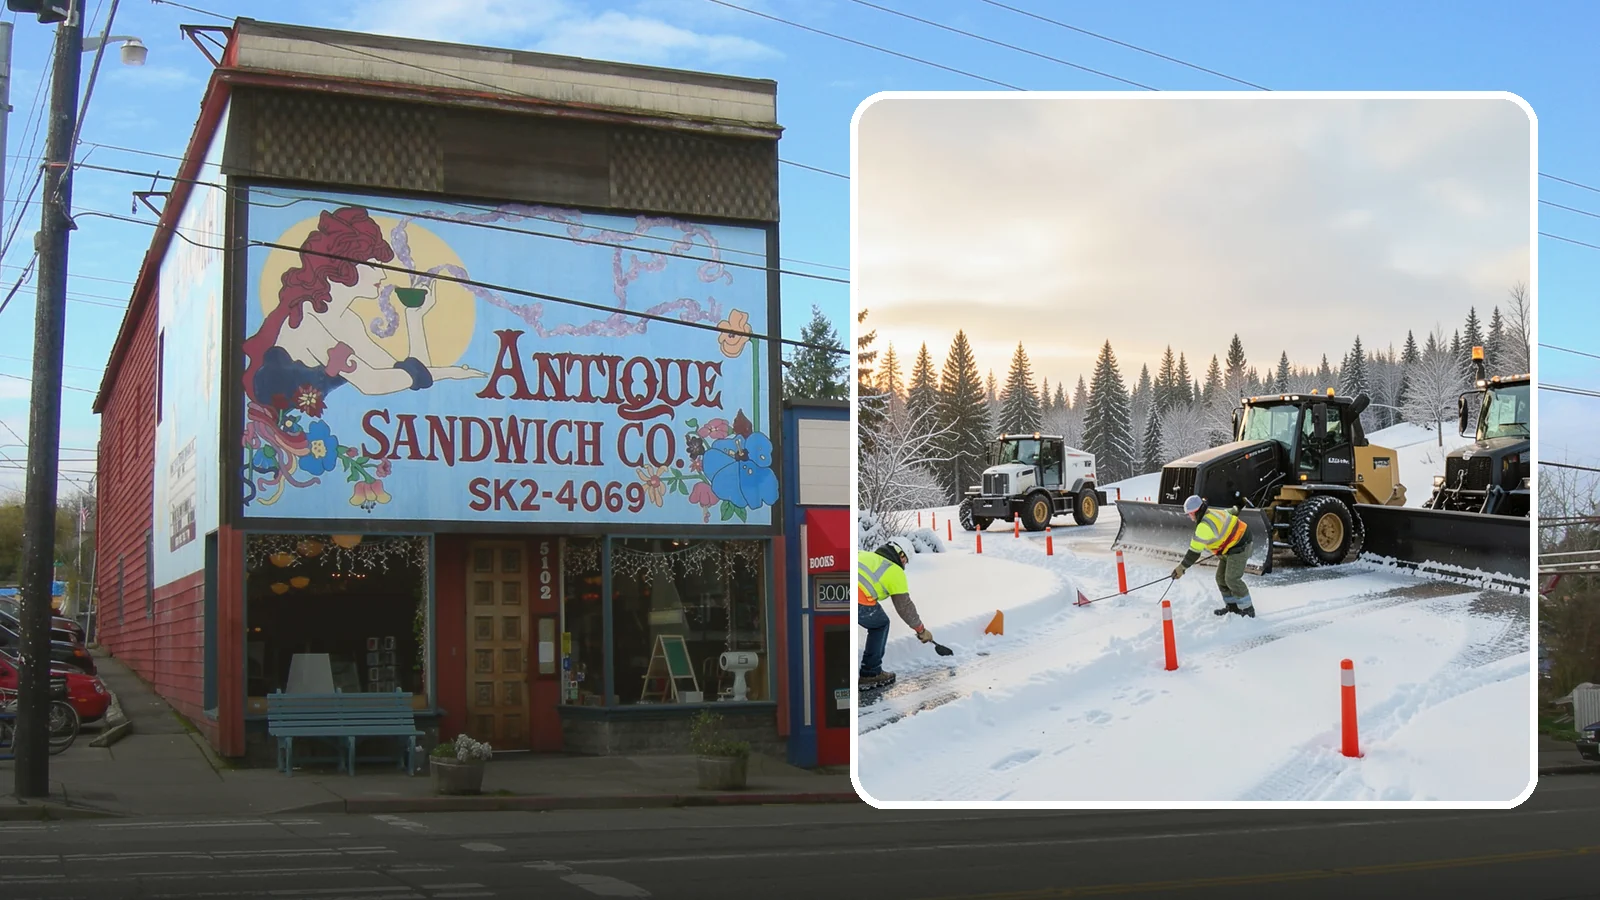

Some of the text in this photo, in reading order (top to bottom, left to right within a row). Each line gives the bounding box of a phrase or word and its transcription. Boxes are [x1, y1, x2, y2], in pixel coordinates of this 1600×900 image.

[476, 329, 723, 420] ANTIQUE
[361, 409, 684, 468] SANDWICH CO.
[469, 478, 645, 512] SK2-4069
[539, 541, 552, 599] 5102
[809, 555, 835, 569] BOOKS
